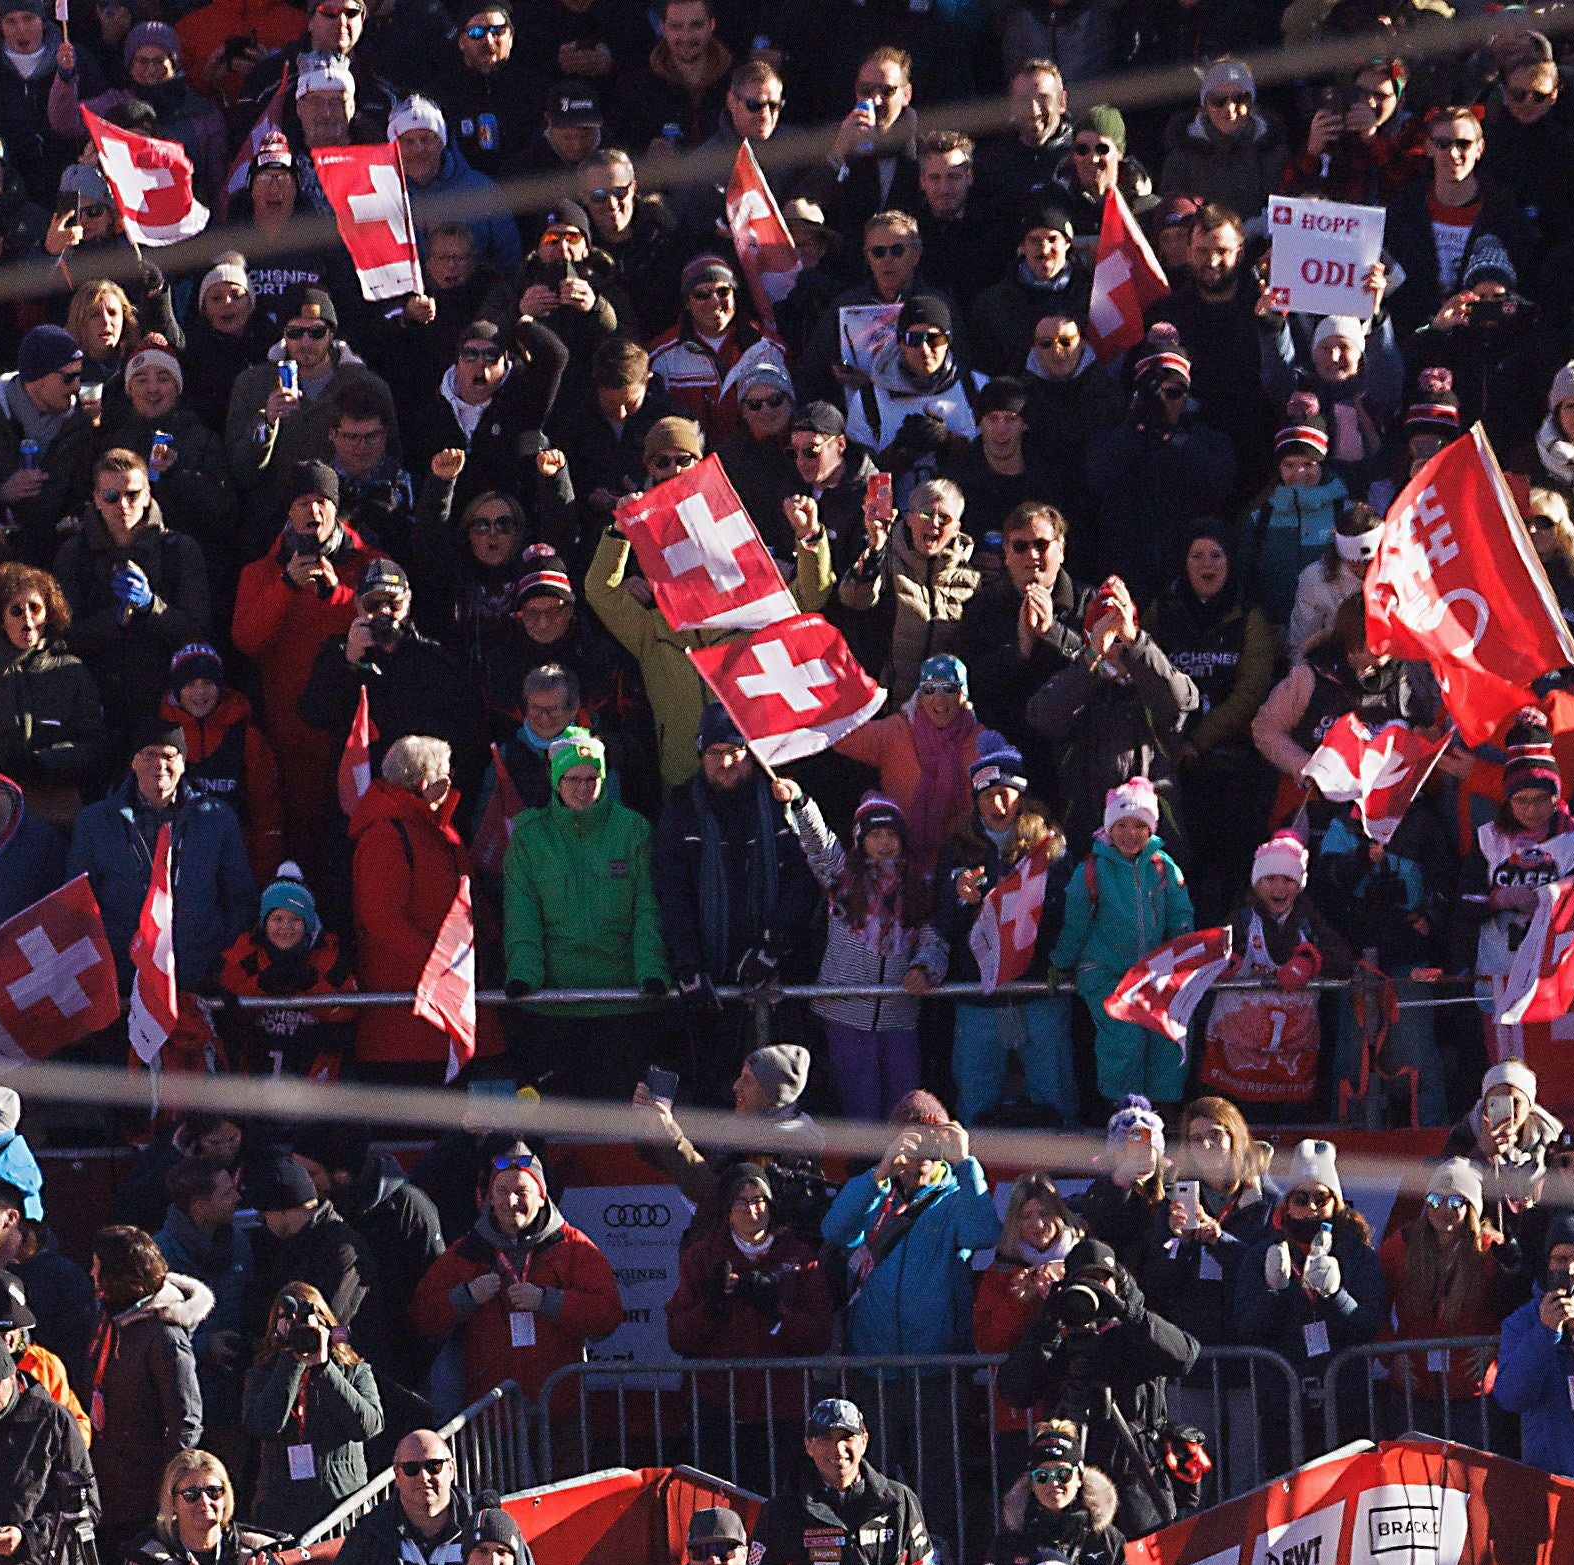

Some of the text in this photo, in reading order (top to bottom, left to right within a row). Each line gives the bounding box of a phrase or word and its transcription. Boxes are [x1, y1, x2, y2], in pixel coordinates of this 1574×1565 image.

[1301, 212, 1360, 235] HOPP
[1300, 258, 1356, 288] ODI
[1261, 1010, 1288, 1053] 1
